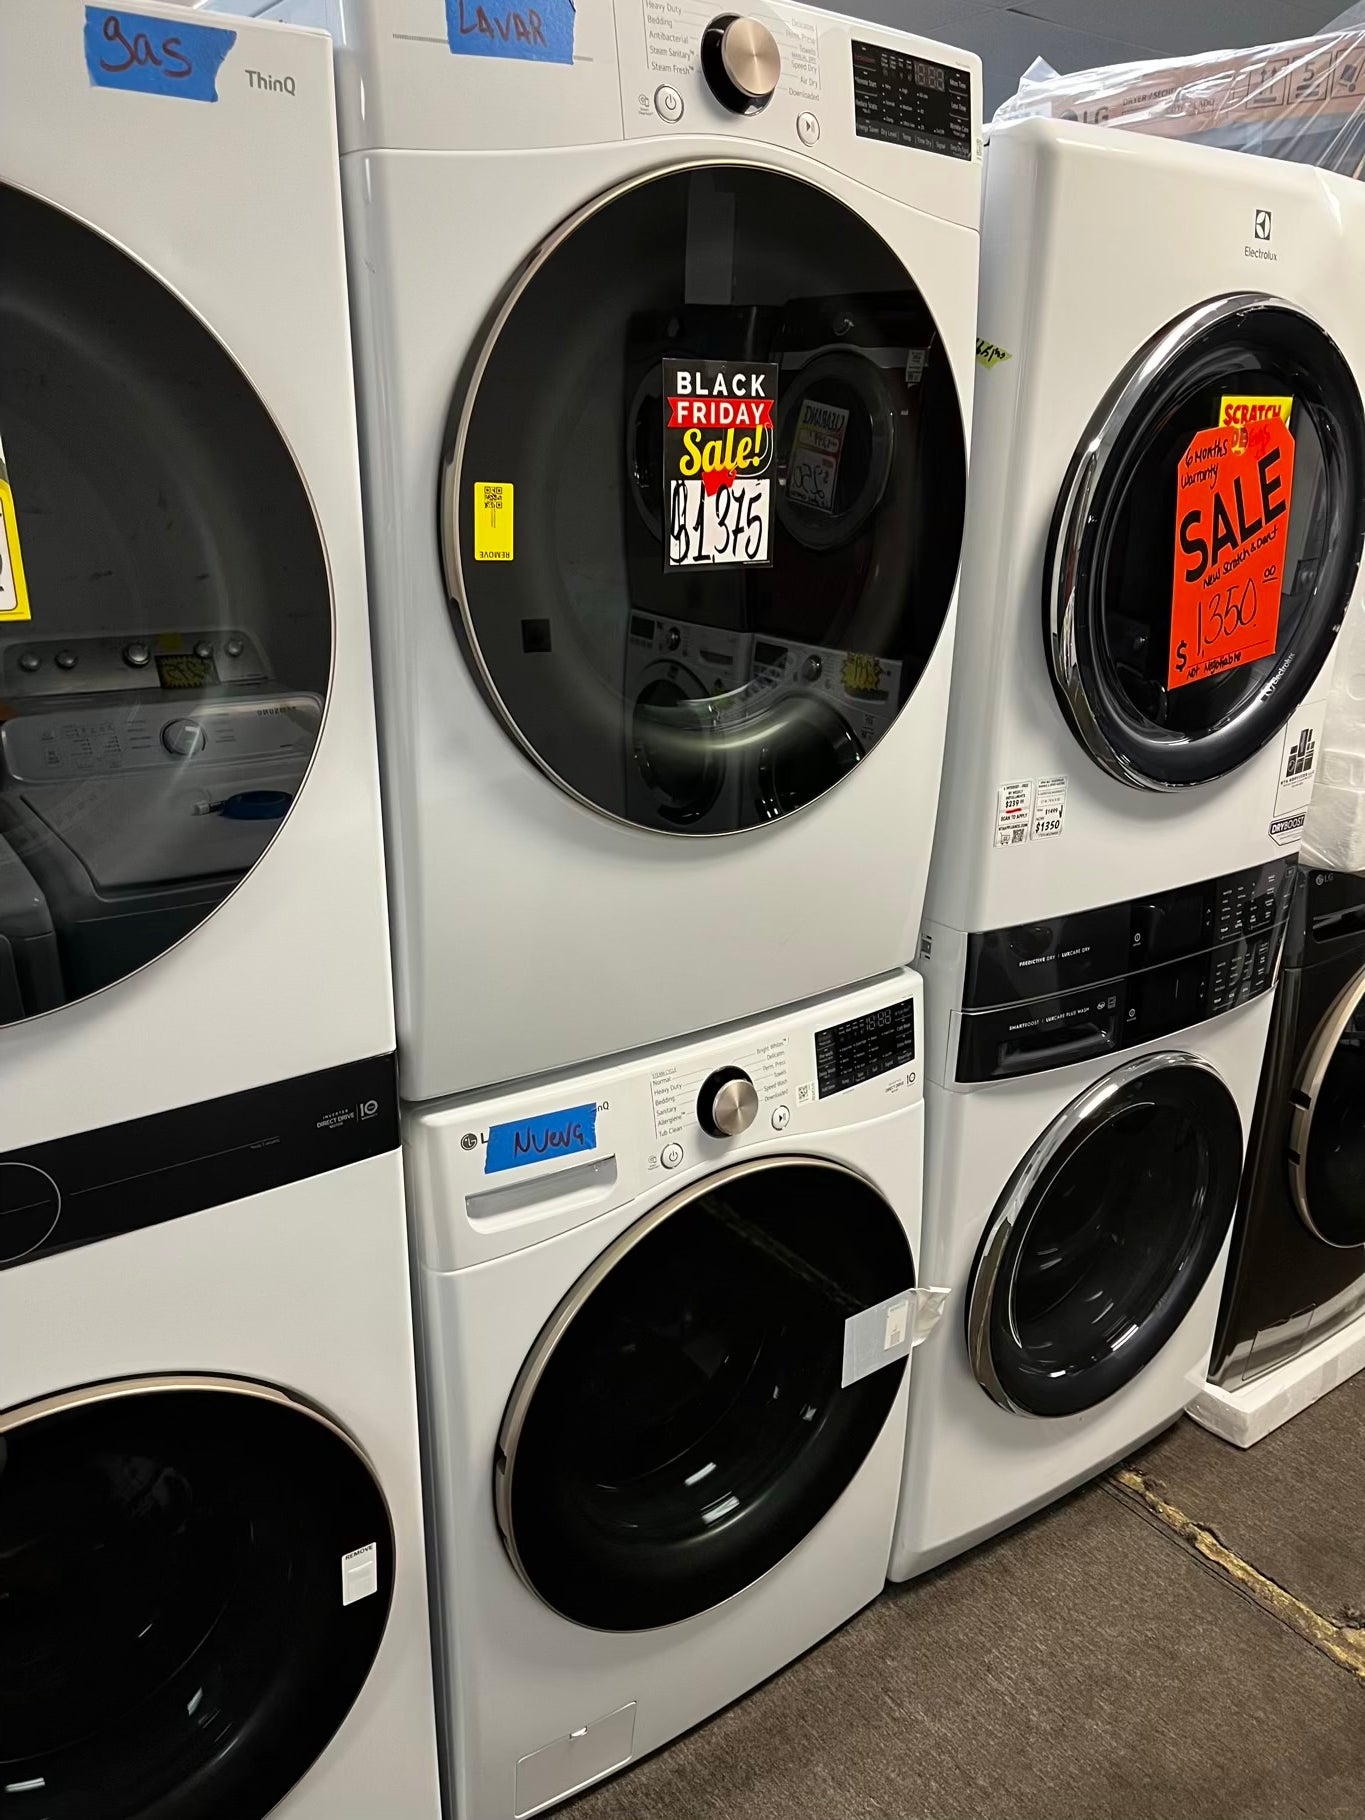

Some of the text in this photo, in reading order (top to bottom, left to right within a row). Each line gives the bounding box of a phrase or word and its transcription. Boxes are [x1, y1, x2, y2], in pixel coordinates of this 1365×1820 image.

[666, 3, 682, 16] Duty
[457, 0, 548, 49] LAVAR
[647, 15, 673, 29] Bedding
[649, 30, 689, 44] Antibacterial
[101, 15, 192, 78] gas
[649, 45, 668, 56] Steam
[651, 61, 672, 73] Steam
[245, 69, 296, 97] ThinQ
[1244, 245, 1278, 262] Electrolux
[676, 370, 766, 397] BLACK
[677, 401, 765, 425] FRIDAY
[1223, 403, 1282, 426] SCRATCH
[679, 423, 764, 476] Sale!
[1185, 447, 1194, 468] 6
[1179, 446, 1287, 584] SALE
[479, 551, 511, 560] REMOVE
[1175, 640, 1188, 673] $
[1270, 652, 1296, 686] Electrolux
[1035, 819, 1060, 834] $1350
[1270, 813, 1306, 835] DRYBOOST
[1018, 956, 1046, 968] PREDICTIVE
[1061, 948, 1081, 958] LUXCARE
[1081, 946, 1091, 954] DRY
[1008, 1019, 1040, 1031] SMARTBOOST
[1045, 1012, 1065, 1023] LUXCARE
[652, 1076, 671, 1086] Normal
[653, 1082, 682, 1096] Heavy Duty
[655, 1095, 676, 1107] Bedding
[316, 1117, 337, 1129] DIRECT
[337, 1111, 355, 1122] DRIVE
[656, 1106, 677, 1117] Sanitary
[668, 1125, 683, 1135] Clean
[344, 1544, 374, 1561] REMOVE
